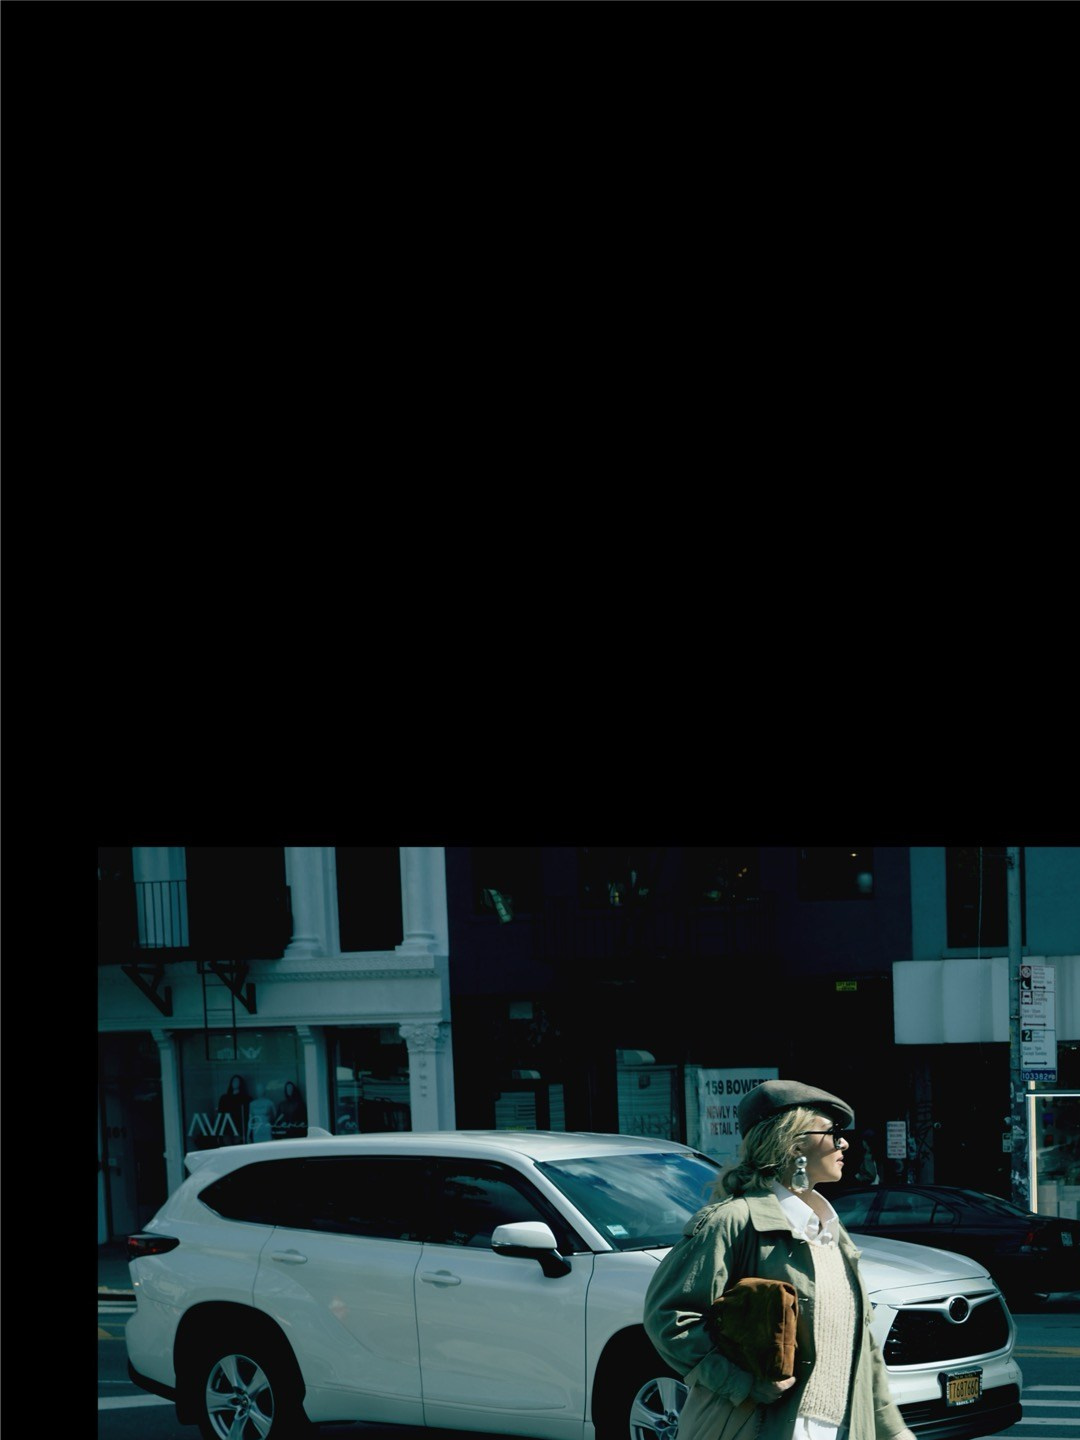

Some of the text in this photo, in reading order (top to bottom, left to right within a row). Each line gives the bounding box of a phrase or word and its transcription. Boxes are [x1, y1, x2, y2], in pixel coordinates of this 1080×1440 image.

[706, 1080, 724, 1094] 159
[707, 1105, 730, 1118] NEWLY
[188, 1113, 239, 1136] AVA
[710, 1122, 732, 1135] RETAIL
